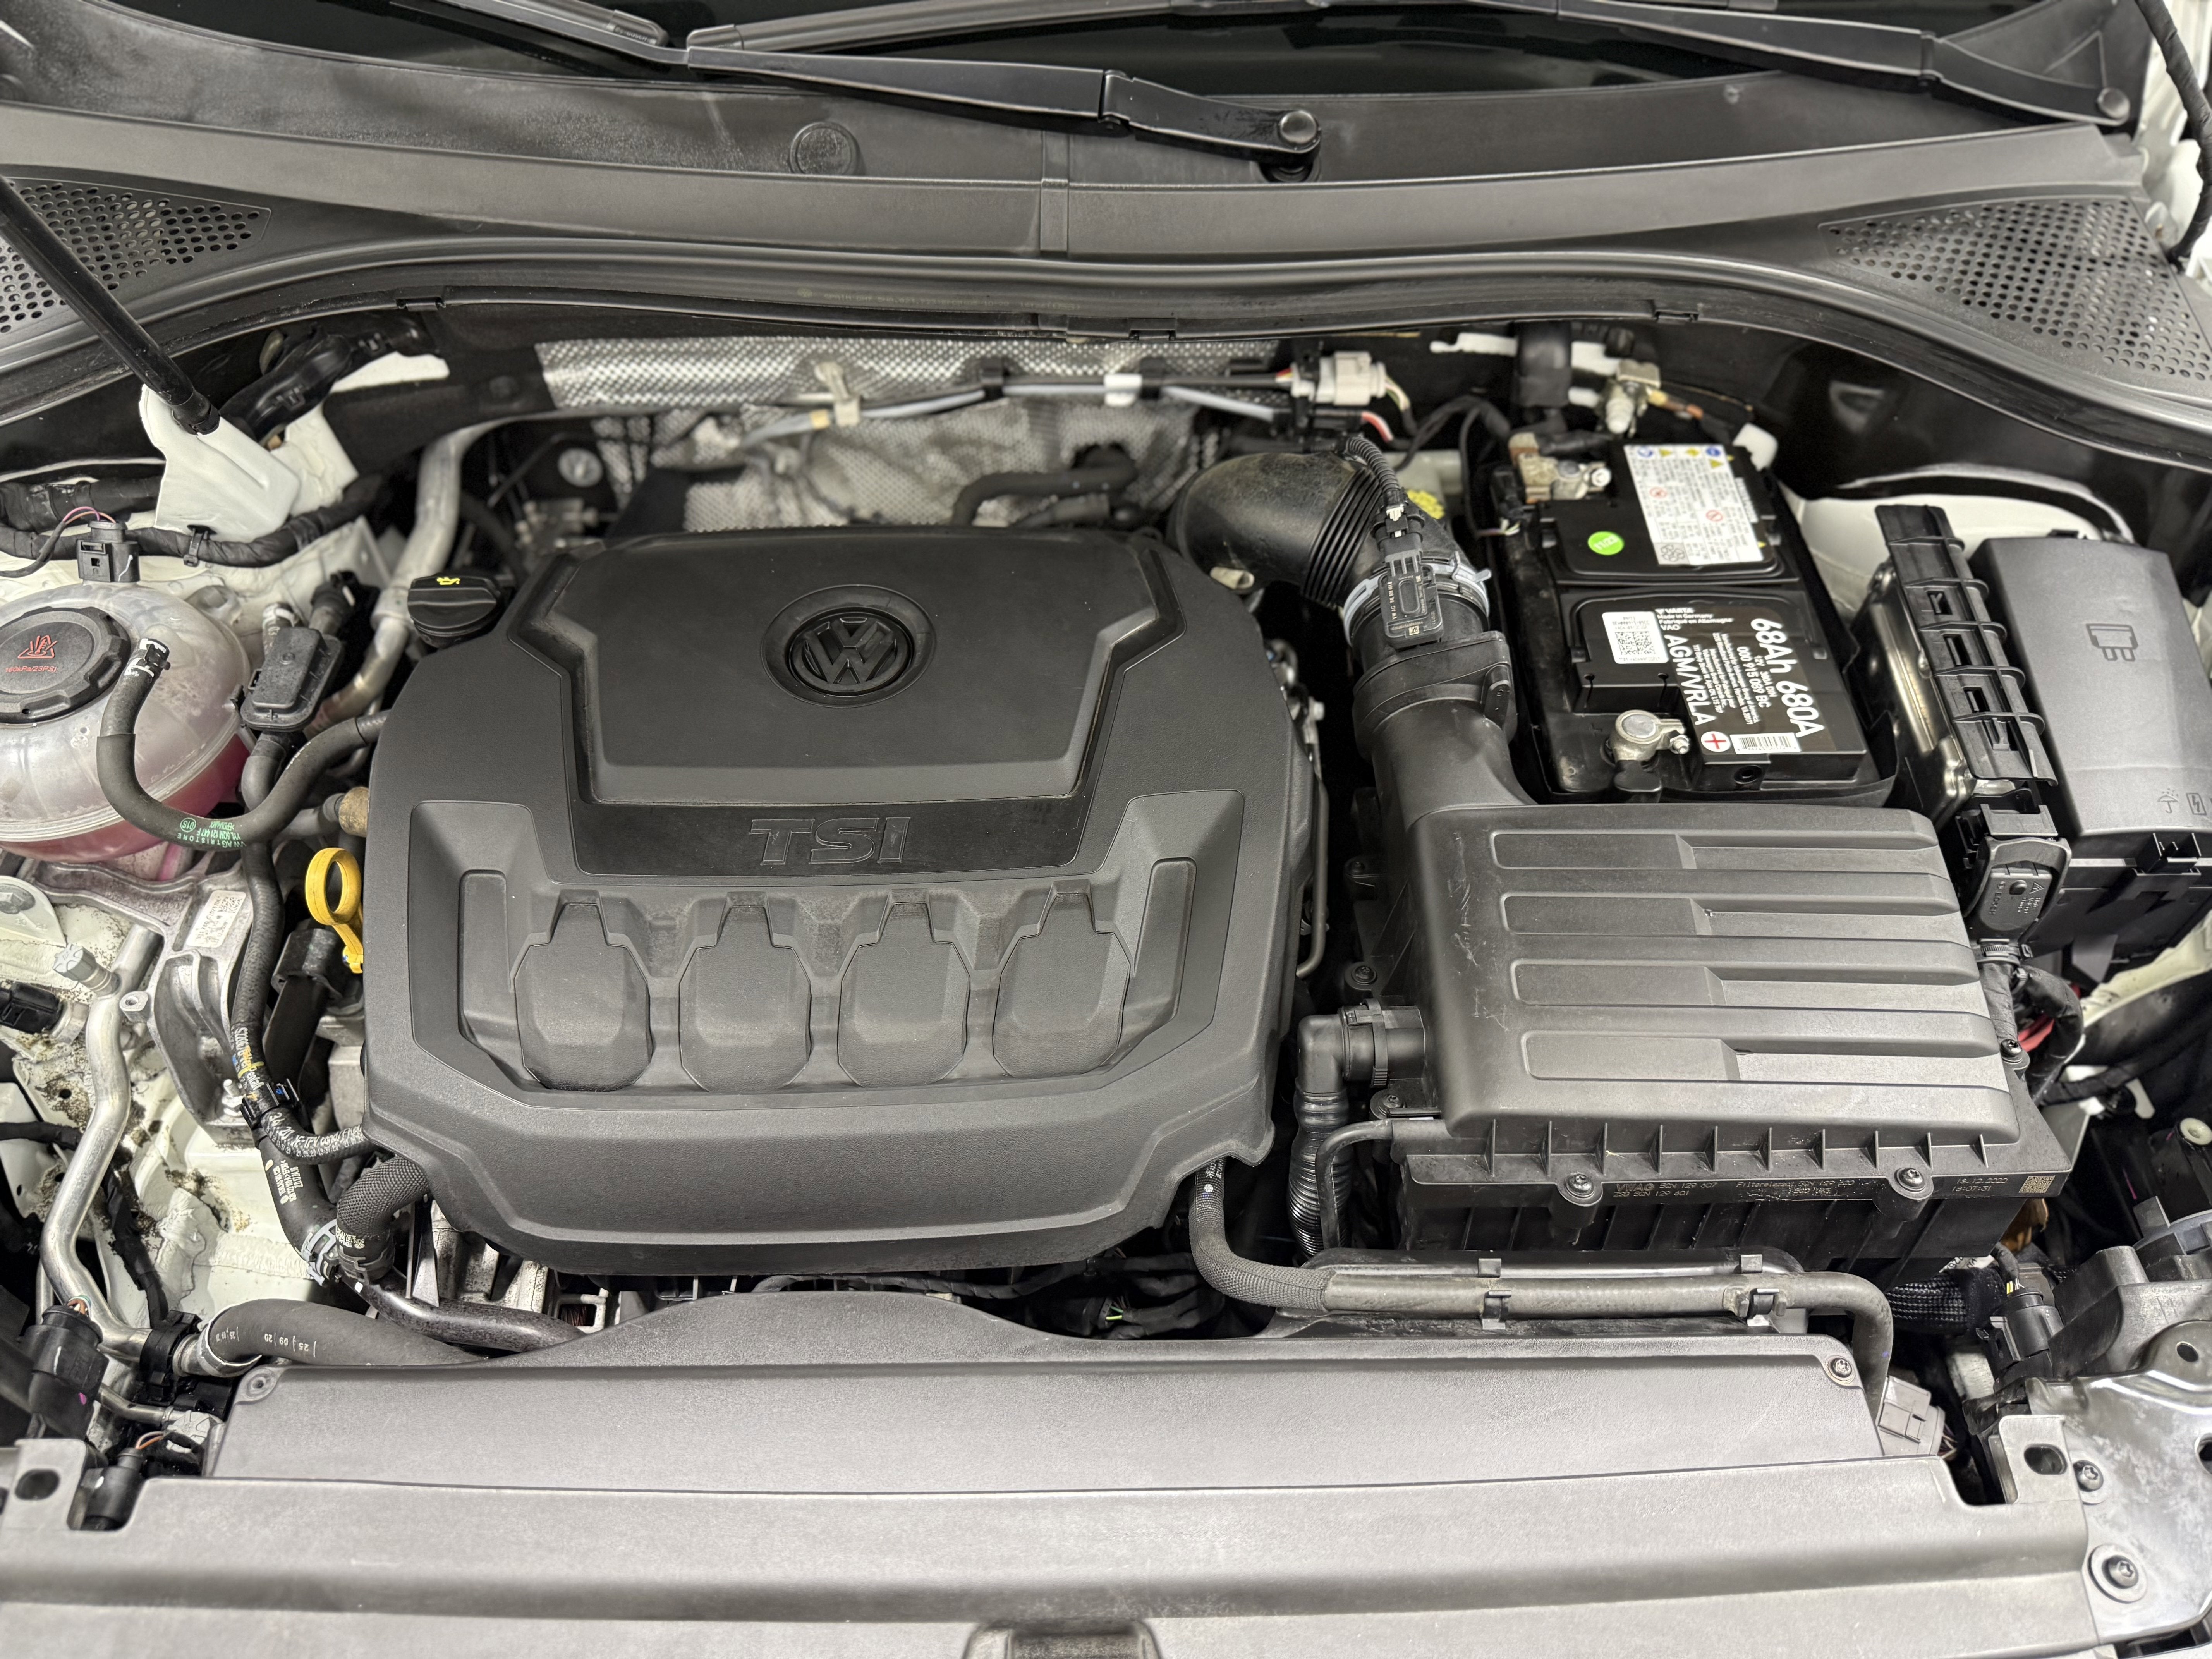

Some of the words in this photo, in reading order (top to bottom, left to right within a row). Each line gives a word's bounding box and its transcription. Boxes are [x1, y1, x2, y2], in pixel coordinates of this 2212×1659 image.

[1737, 646, 1753, 661] 000
[1743, 663, 1759, 677] 915
[1750, 618, 1798, 673] 68Ah
[1776, 681, 1825, 738] 680A
[1664, 635, 1717, 725] AGM/VRLA
[1749, 678, 1766, 694] 089
[1765, 686, 1778, 697] DIN
[749, 817, 911, 866] TSI
